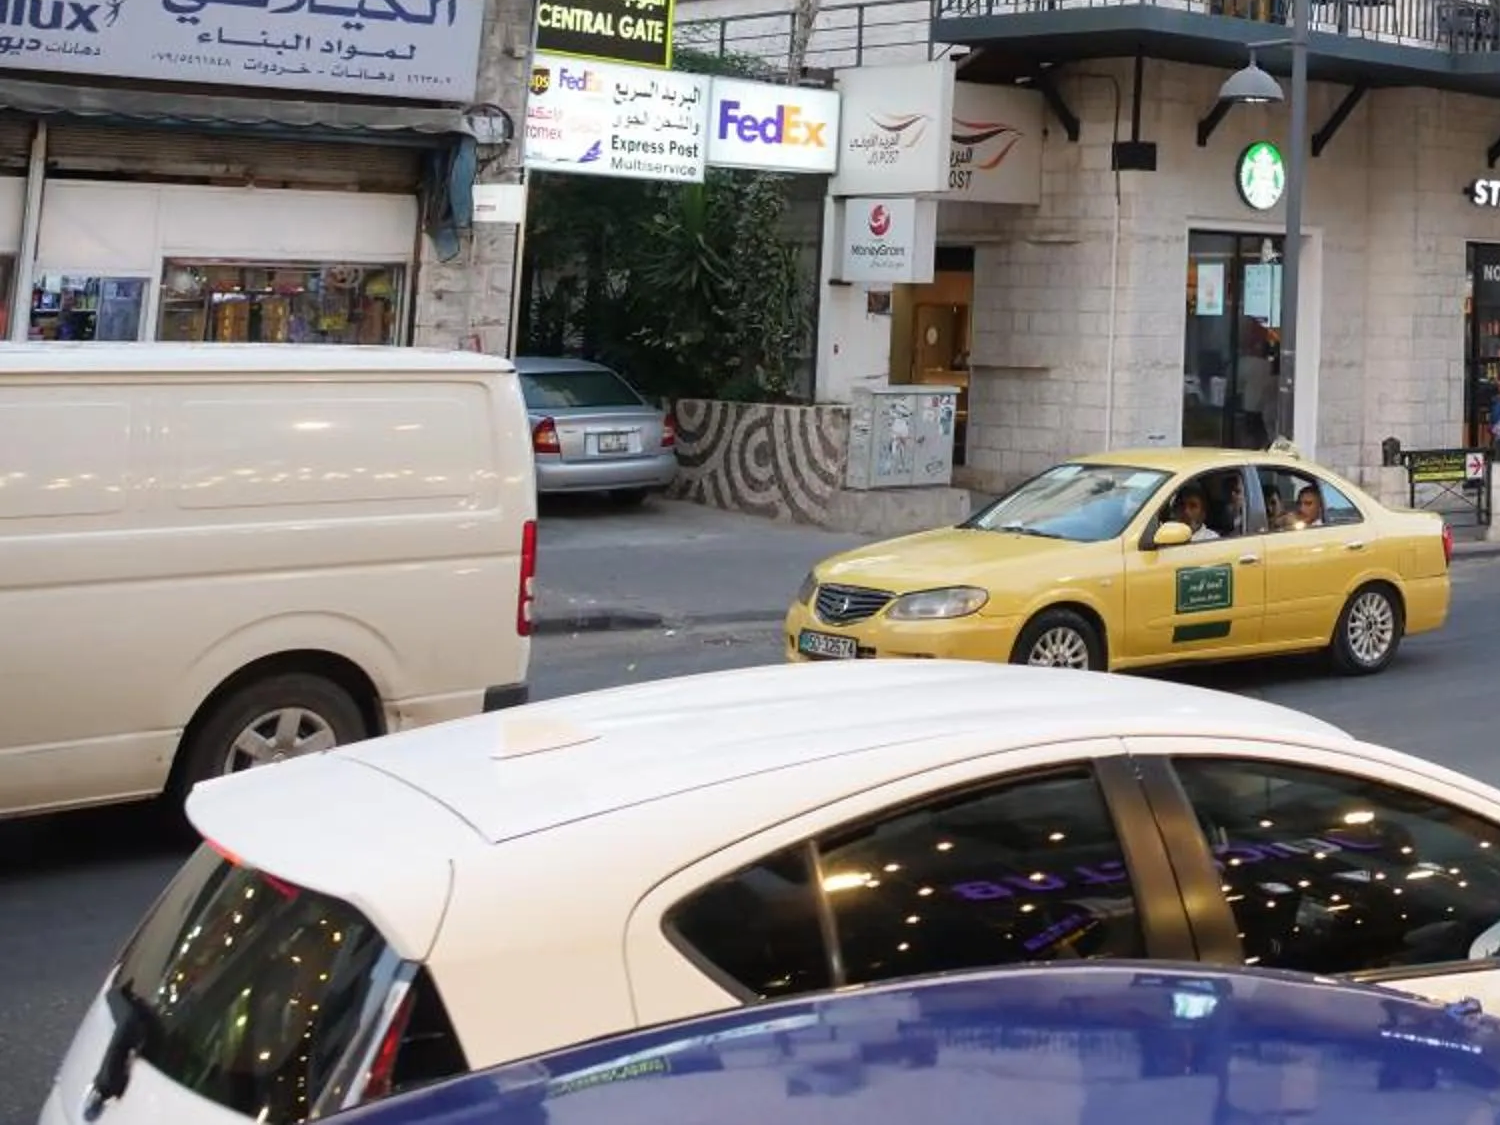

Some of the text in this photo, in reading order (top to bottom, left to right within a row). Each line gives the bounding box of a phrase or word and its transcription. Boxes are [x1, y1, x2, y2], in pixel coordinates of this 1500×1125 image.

[537, 2, 664, 44] CENTRAL GATE
[197, 26, 417, 61] لمواد البناء
[718, 99, 827, 148] FedEx
[611, 134, 699, 159] Express Post
[610, 156, 697, 177] Multiservice
